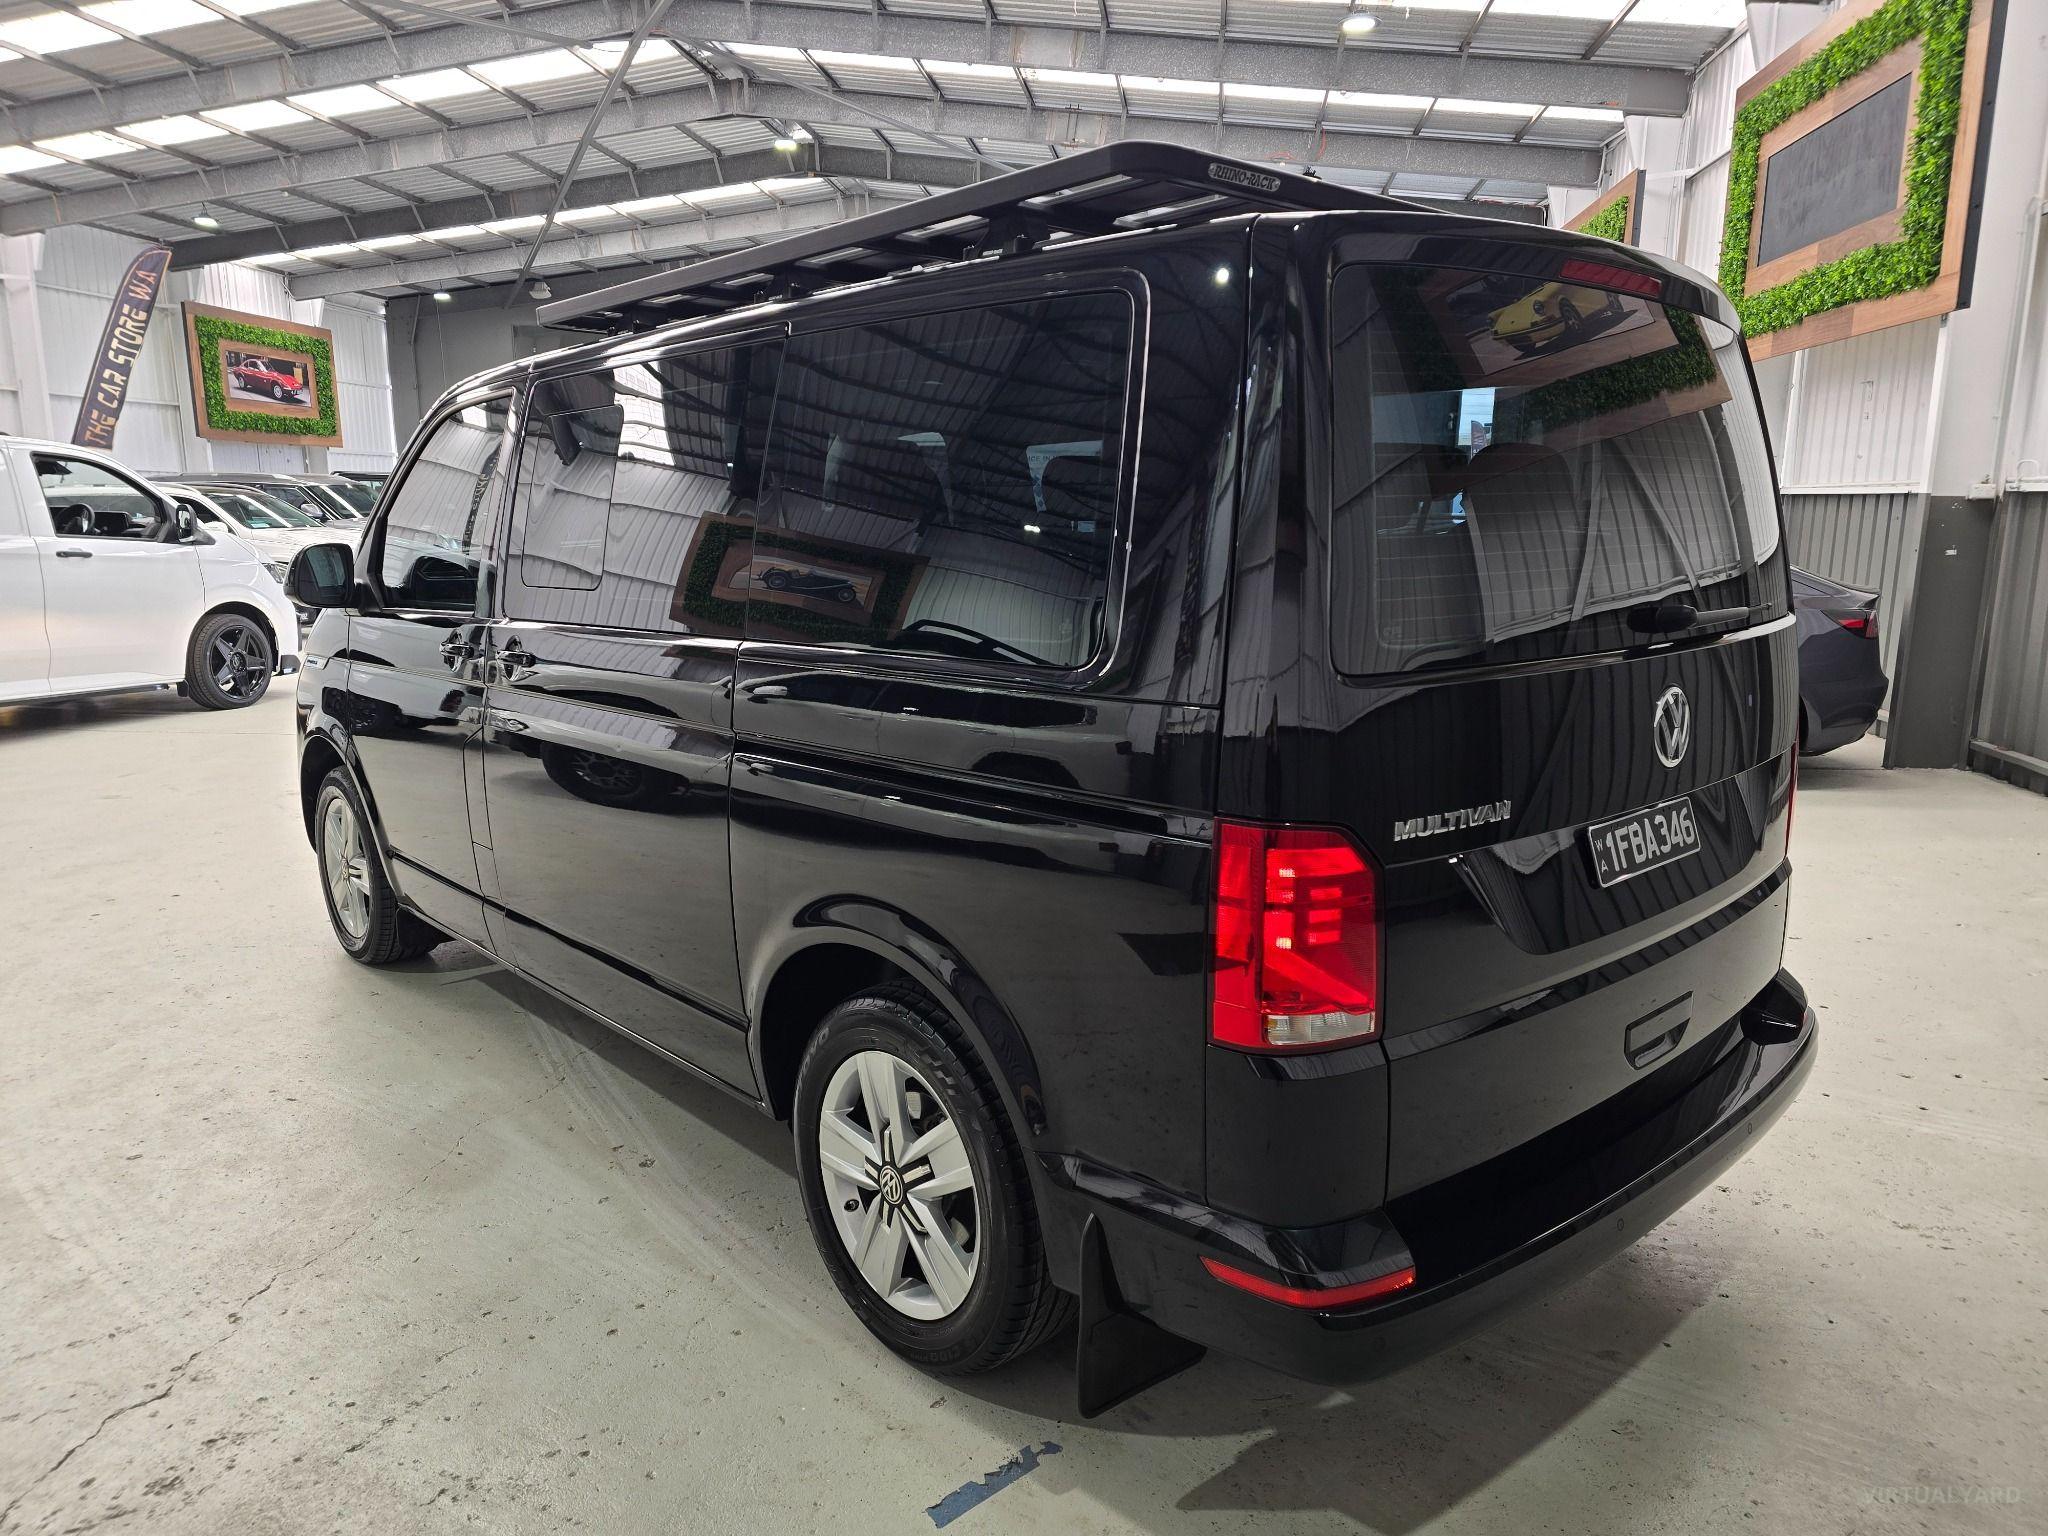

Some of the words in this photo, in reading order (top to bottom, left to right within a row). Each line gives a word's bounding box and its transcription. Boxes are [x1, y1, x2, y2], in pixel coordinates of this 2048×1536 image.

[1214, 165, 1275, 190] RHINO-RACK
[128, 270, 157, 301] WA
[108, 304, 148, 368] STORE
[97, 370, 127, 407] CAR
[85, 409, 116, 445] THE
[1394, 800, 1511, 841] MULTIVAN
[1606, 807, 1695, 871] 1FBA346
